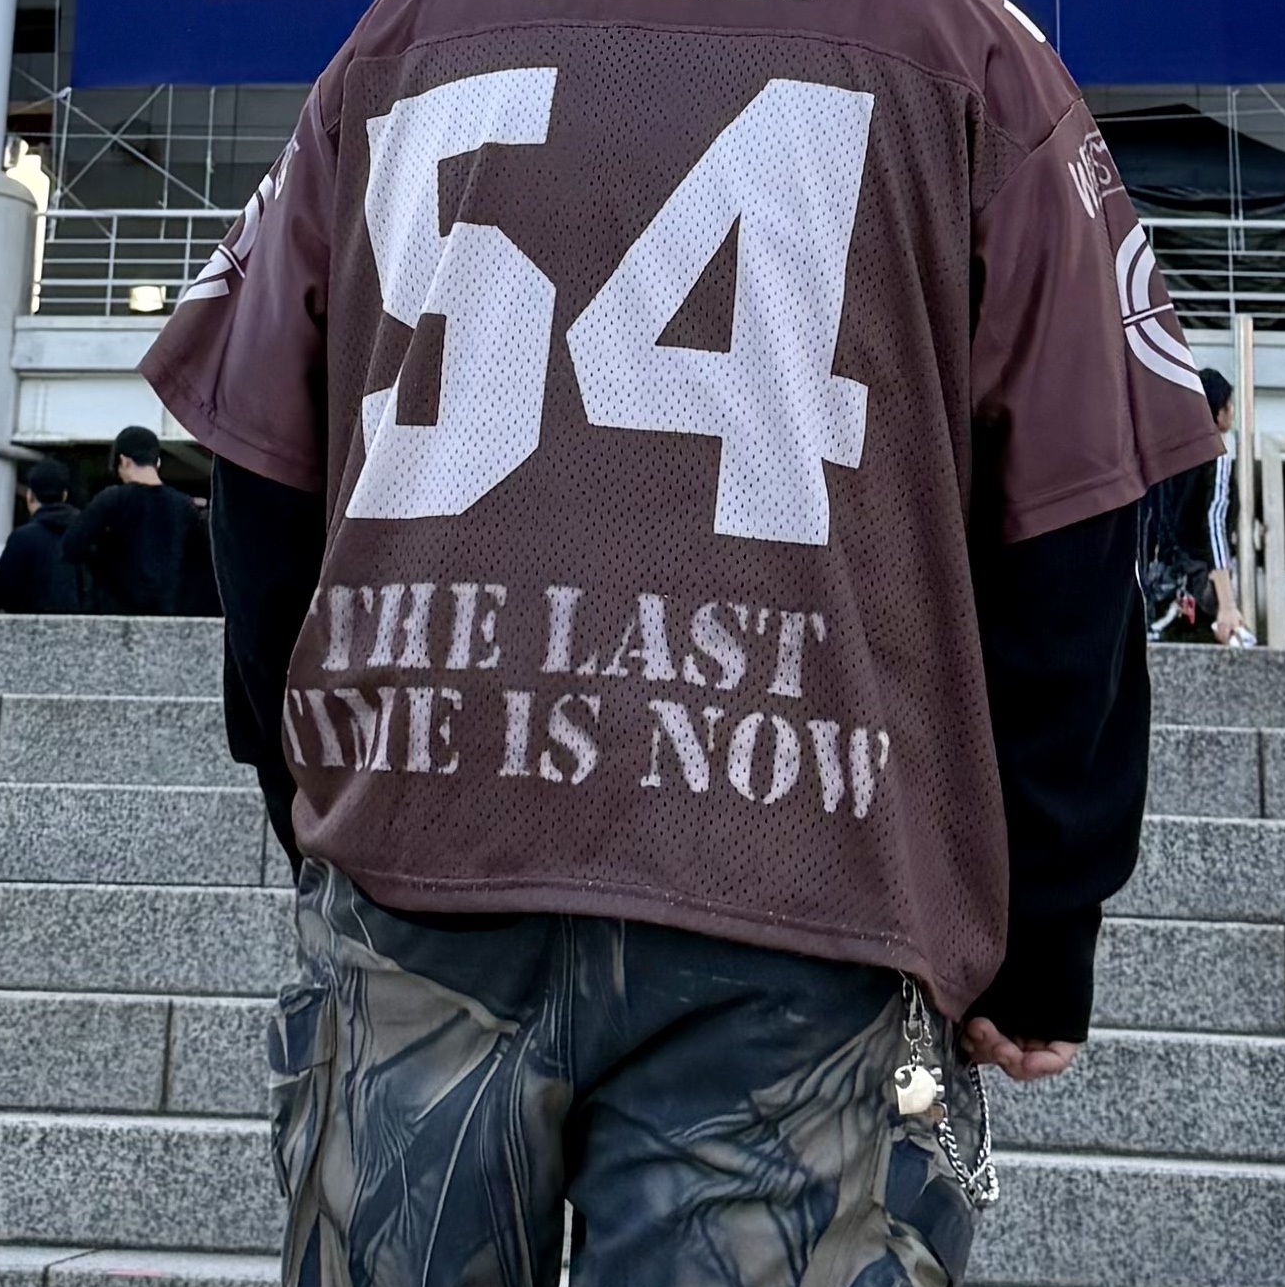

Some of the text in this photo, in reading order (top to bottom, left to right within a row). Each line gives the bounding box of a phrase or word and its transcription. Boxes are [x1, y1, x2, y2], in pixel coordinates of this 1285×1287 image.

[346, 68, 875, 546] 54
[308, 584, 826, 698] THE LAST
[501, 692, 601, 785] IS
[642, 699, 890, 819] NOW
